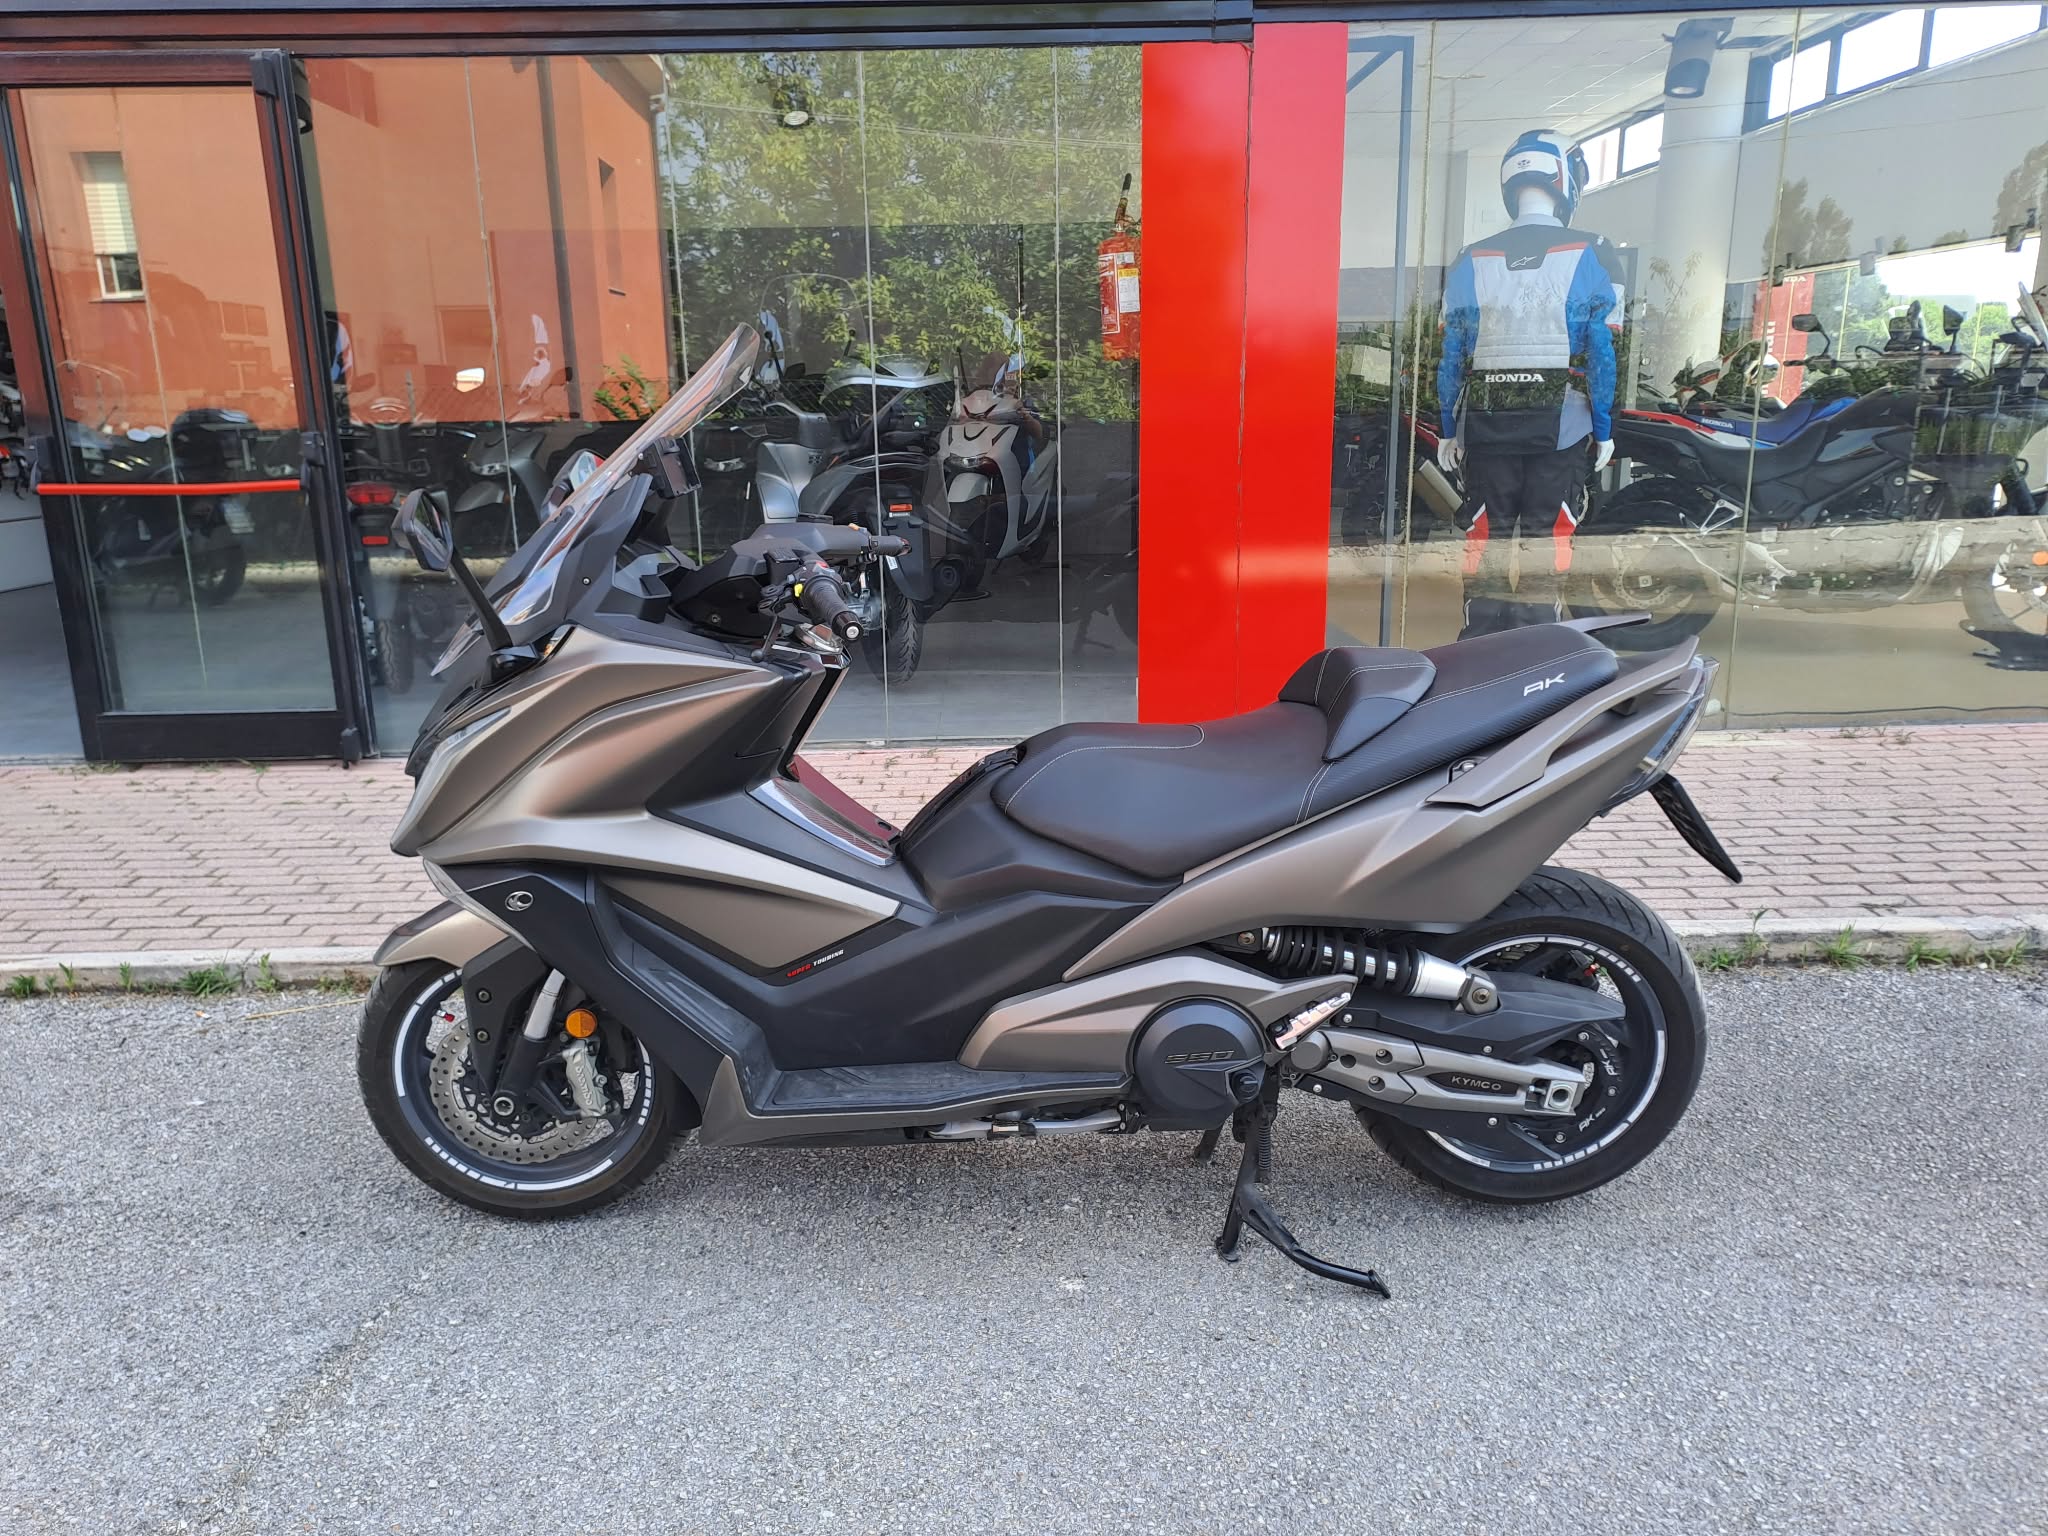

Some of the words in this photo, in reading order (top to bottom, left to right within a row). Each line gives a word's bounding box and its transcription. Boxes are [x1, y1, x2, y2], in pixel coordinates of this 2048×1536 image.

[1484, 373, 1545, 383] HONDA
[1523, 672, 1566, 697] AK
[786, 963, 813, 978] SUPER
[813, 949, 844, 967] TOURING
[1164, 1050, 1235, 1064] 550
[575, 1064, 593, 1105] brembo
[1451, 1075, 1502, 1091] KYMCO
